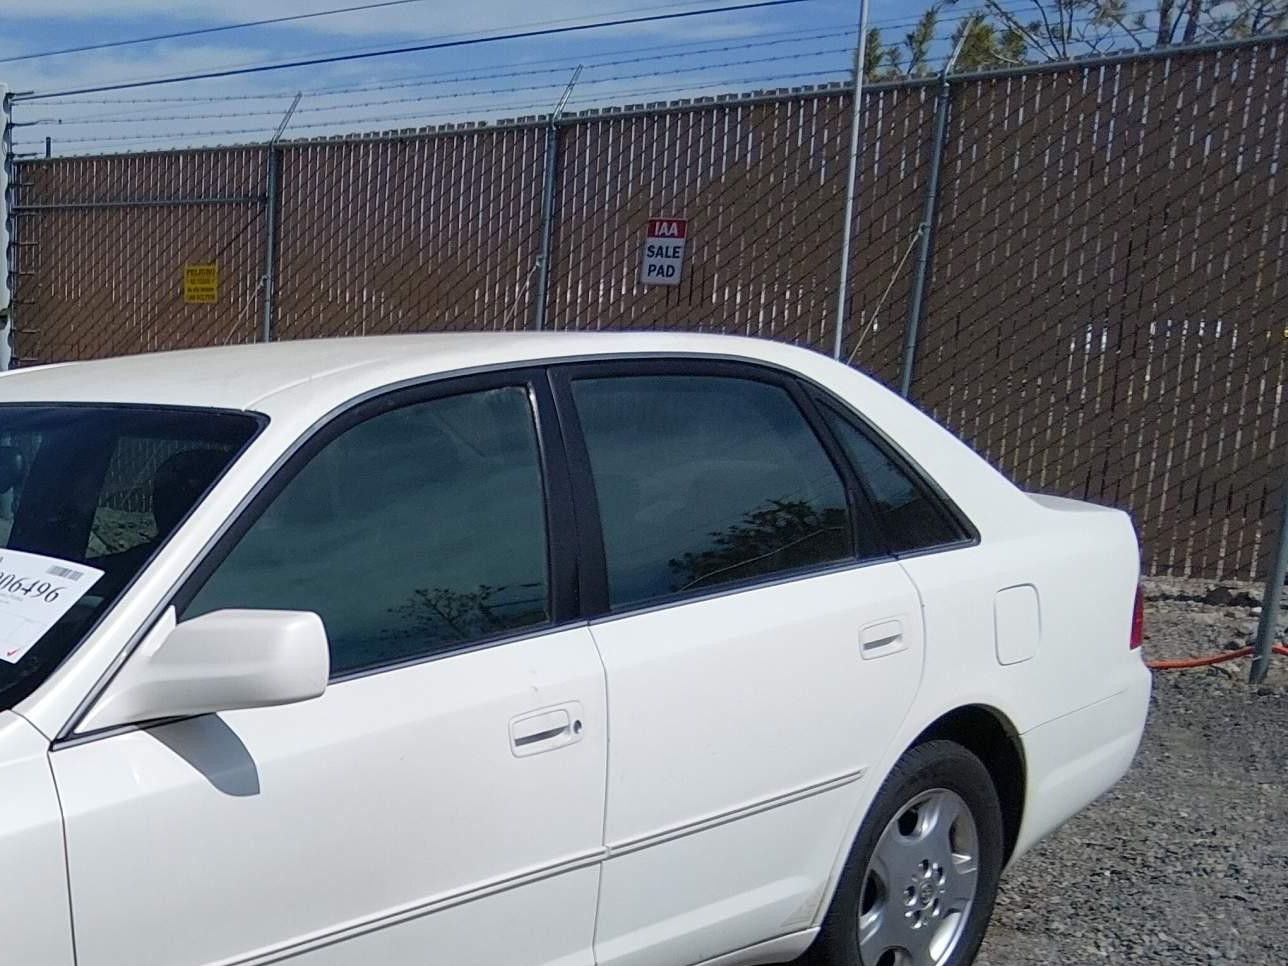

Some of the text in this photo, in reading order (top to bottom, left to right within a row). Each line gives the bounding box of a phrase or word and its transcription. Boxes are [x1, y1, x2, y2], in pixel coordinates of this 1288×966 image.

[655, 222, 678, 236] IAA
[647, 245, 681, 259] SALE
[648, 264, 675, 278] PAD
